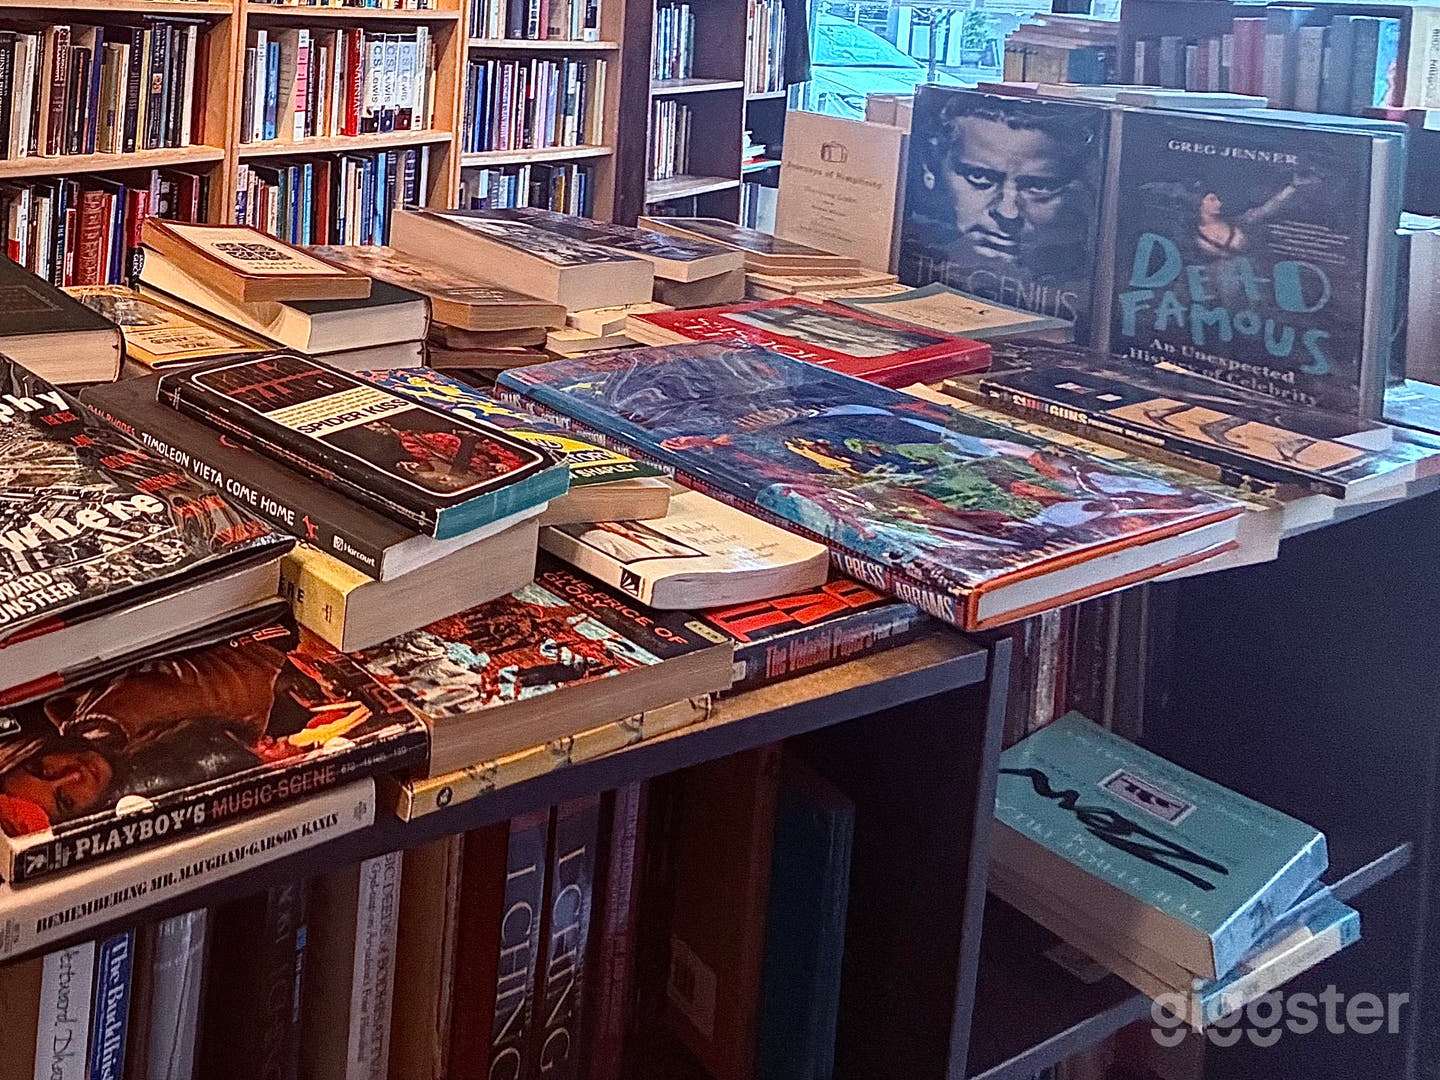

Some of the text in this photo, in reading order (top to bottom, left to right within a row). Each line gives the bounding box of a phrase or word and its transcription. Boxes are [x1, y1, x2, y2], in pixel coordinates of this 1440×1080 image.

[1167, 138, 1299, 165] GREG JENNER
[911, 255, 1080, 322] THE GENIUS
[1128, 231, 1332, 314] DEAD
[1118, 289, 1330, 376] FAMOUS
[1150, 338, 1296, 387] An Unexpected
[296, 397, 414, 437] SPIDER KISS
[141, 431, 190, 467] TIMOLEON
[192, 458, 225, 488] VIETA
[225, 477, 259, 507] COME
[260, 495, 295, 527] HOME
[342, 541, 377, 570] Harcourt
[847, 554, 956, 623] PRESS ABRAMS
[542, 571, 608, 610] GLORY
[36, 881, 148, 935] REMEMBERING
[150, 870, 176, 898] MR.
[540, 887, 587, 1076] CHING
[97, 976, 128, 1080] Buddhis
